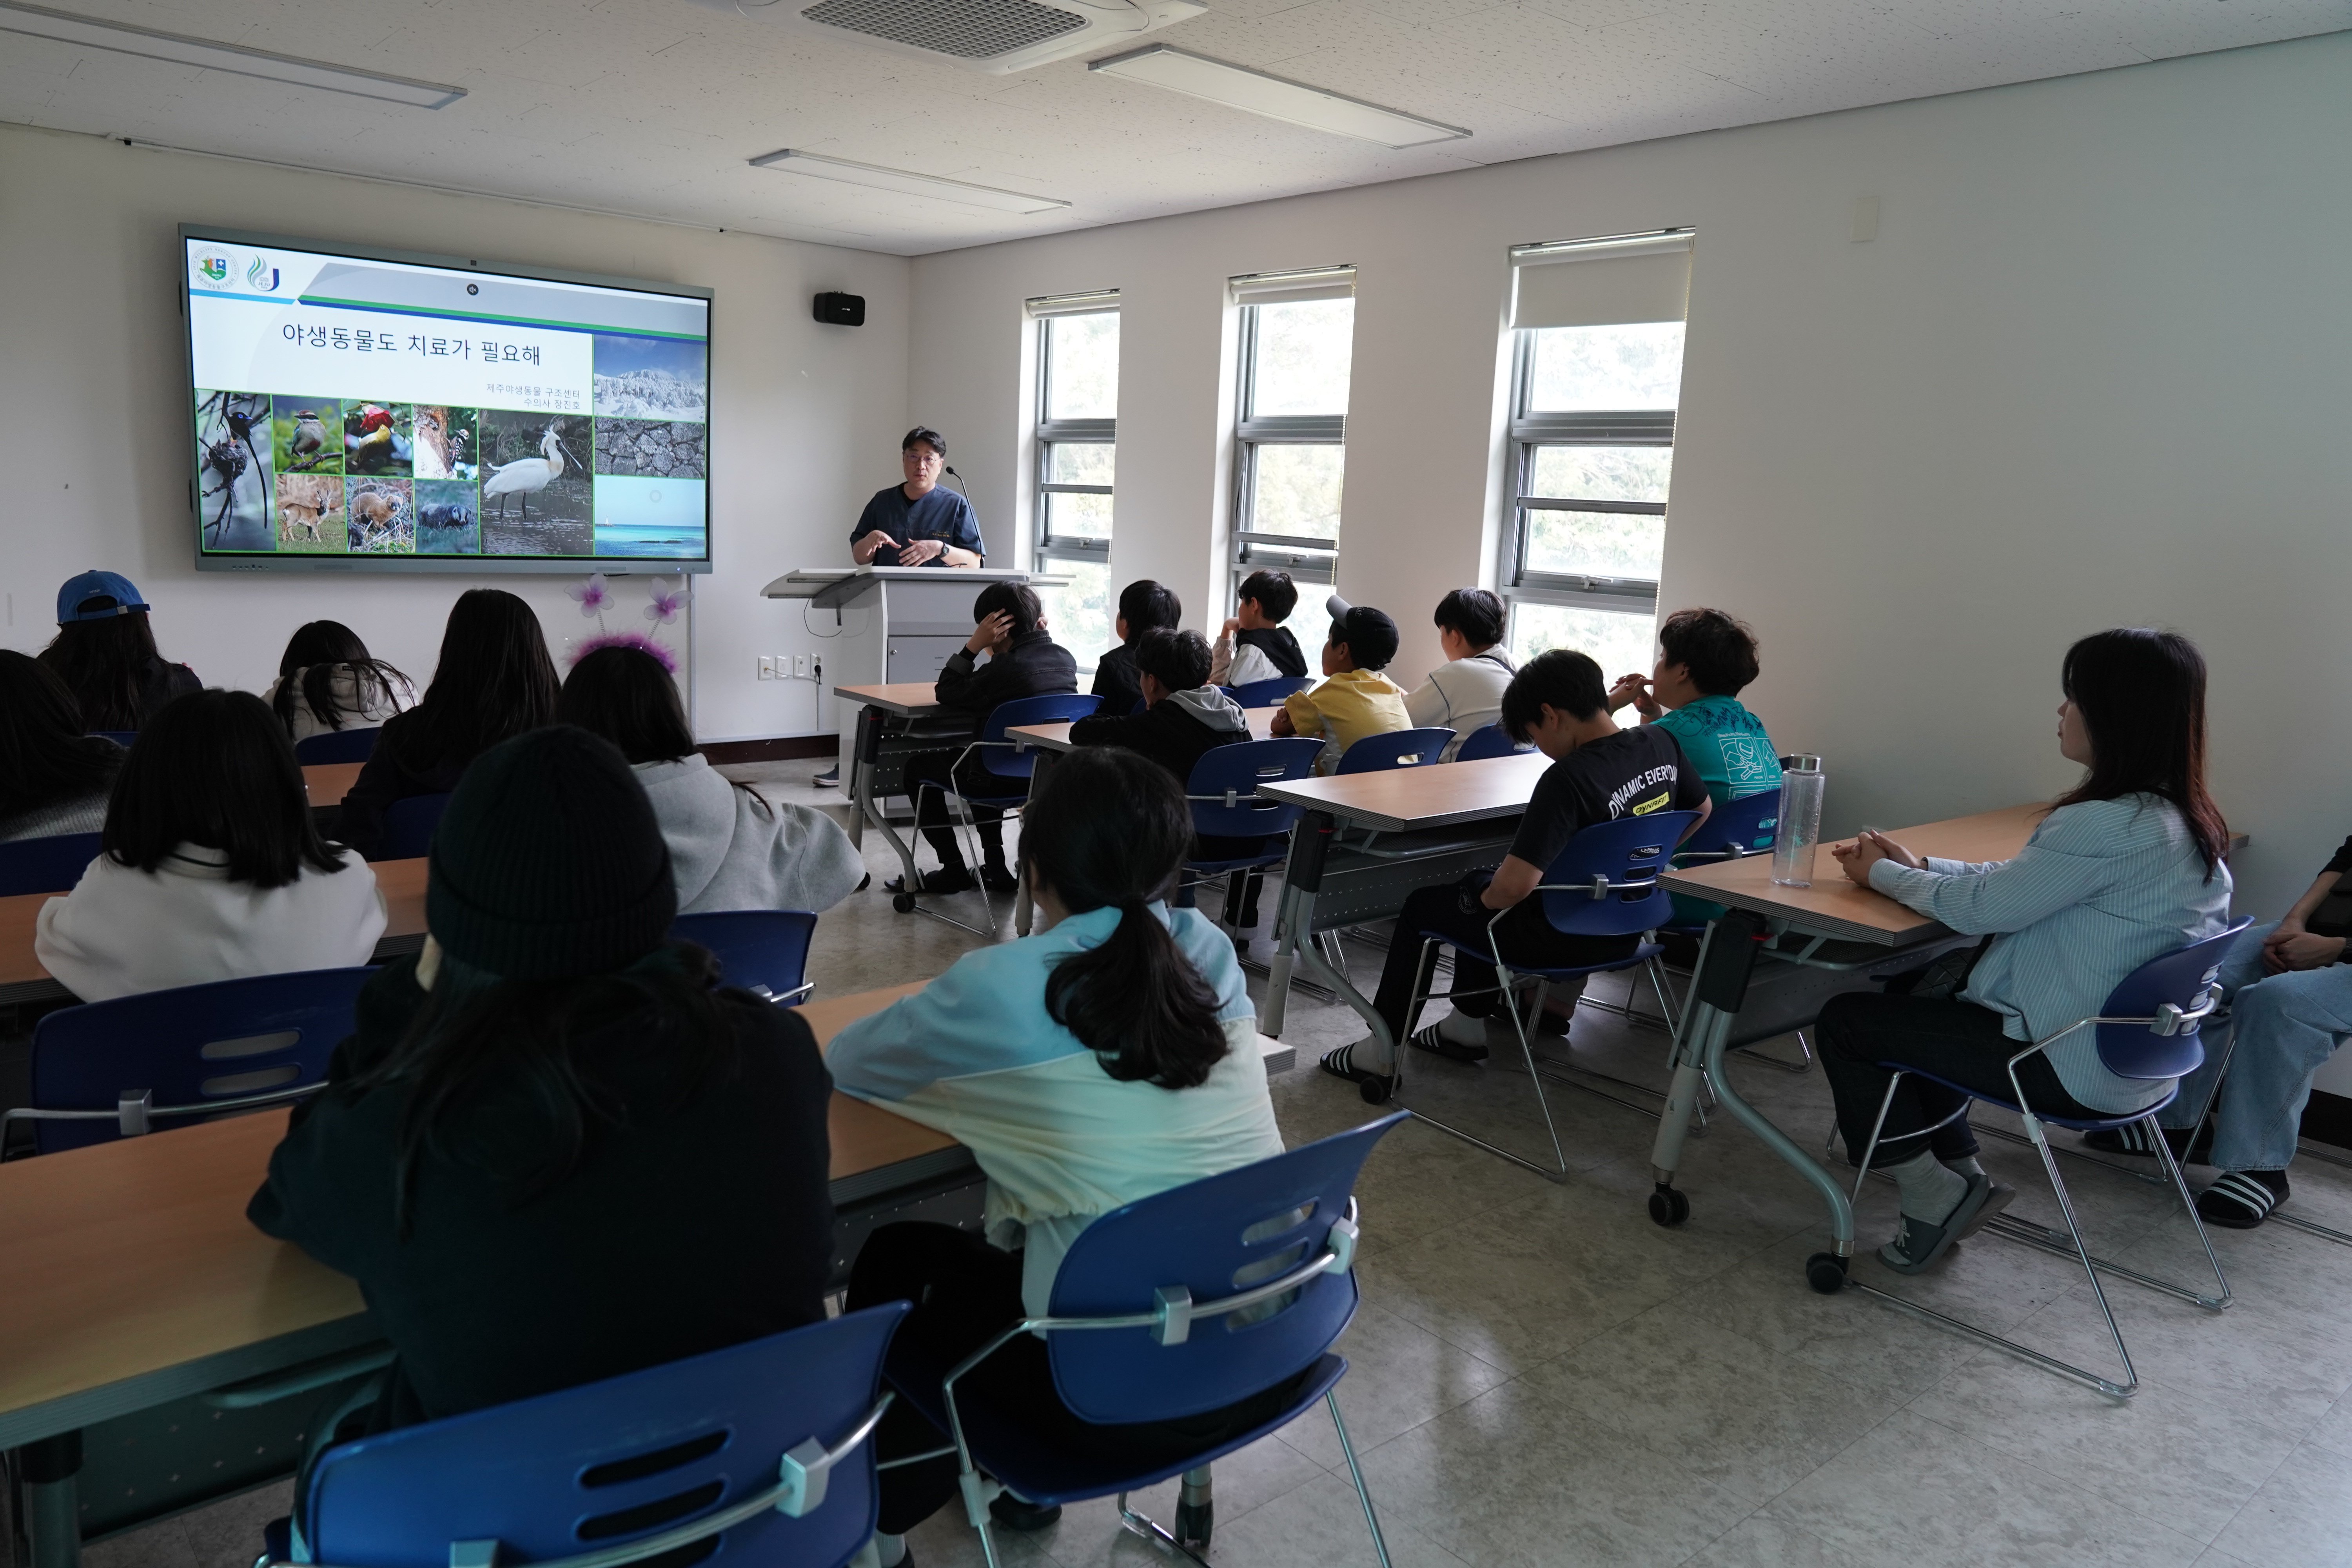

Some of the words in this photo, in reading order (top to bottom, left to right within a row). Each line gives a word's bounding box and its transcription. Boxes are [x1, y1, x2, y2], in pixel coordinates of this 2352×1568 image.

[283, 324, 397, 352] 야생동물도
[408, 334, 471, 360] 치료가
[481, 341, 539, 366] 필요해
[486, 383, 541, 397] 제주야생동물
[545, 388, 580, 399] 구조센터
[524, 397, 551, 408] 수의사
[554, 400, 581, 410] 장진호
[1608, 775, 1646, 820] DYNAMIC
[1635, 795, 1667, 814] DYNAFIT
